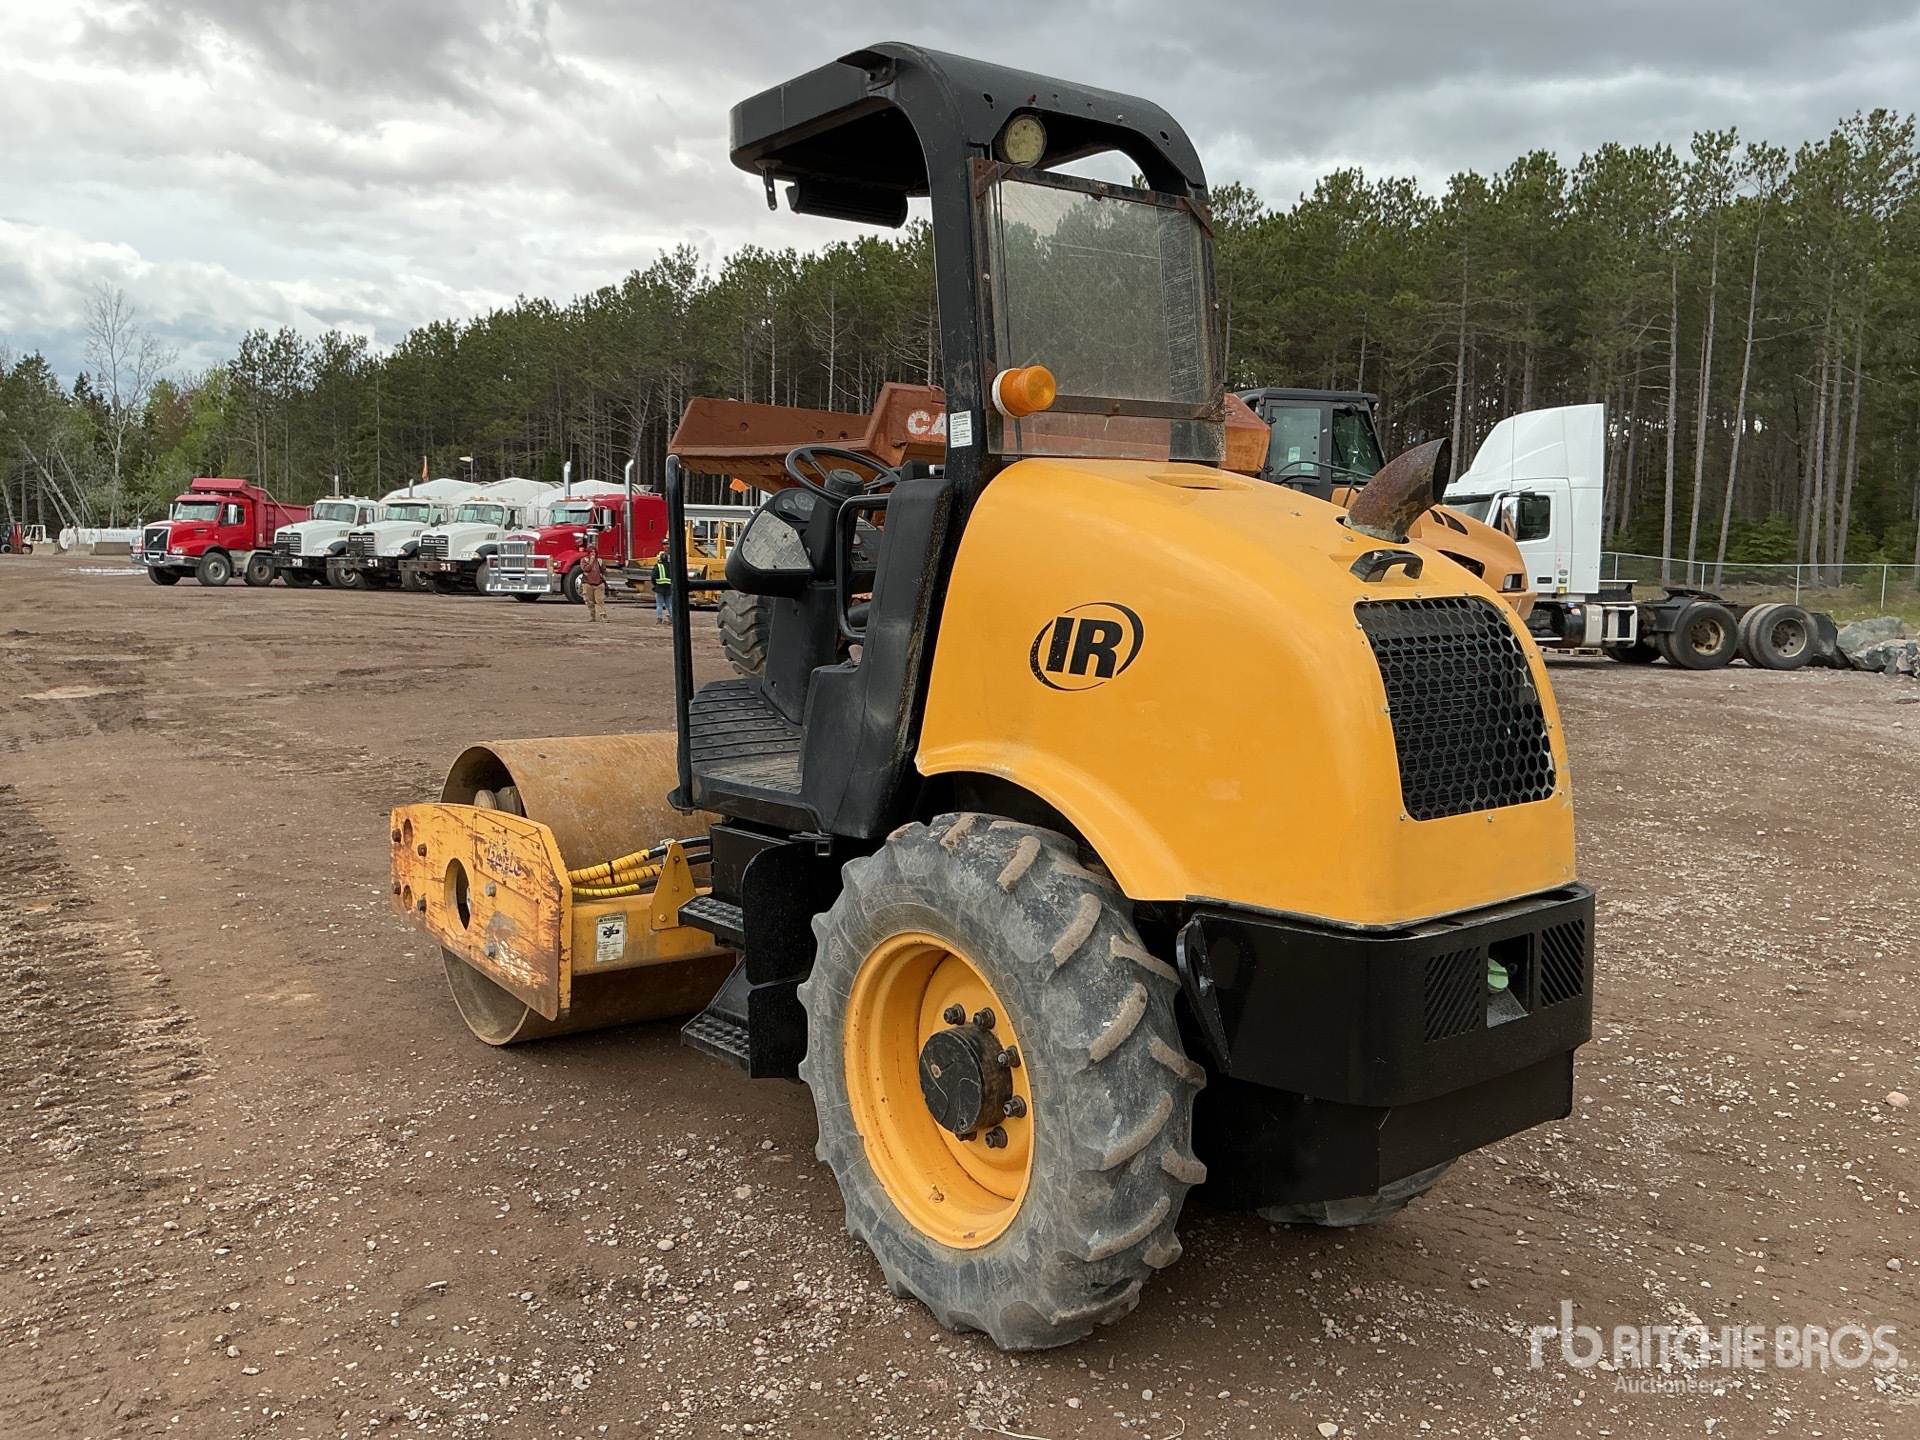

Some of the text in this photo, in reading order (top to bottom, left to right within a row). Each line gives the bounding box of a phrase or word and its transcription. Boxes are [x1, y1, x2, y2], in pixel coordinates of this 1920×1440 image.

[291, 558, 303, 567] 28
[367, 558, 378, 568] 21
[440, 562, 451, 571] 31
[1045, 616, 1123, 679] IR
